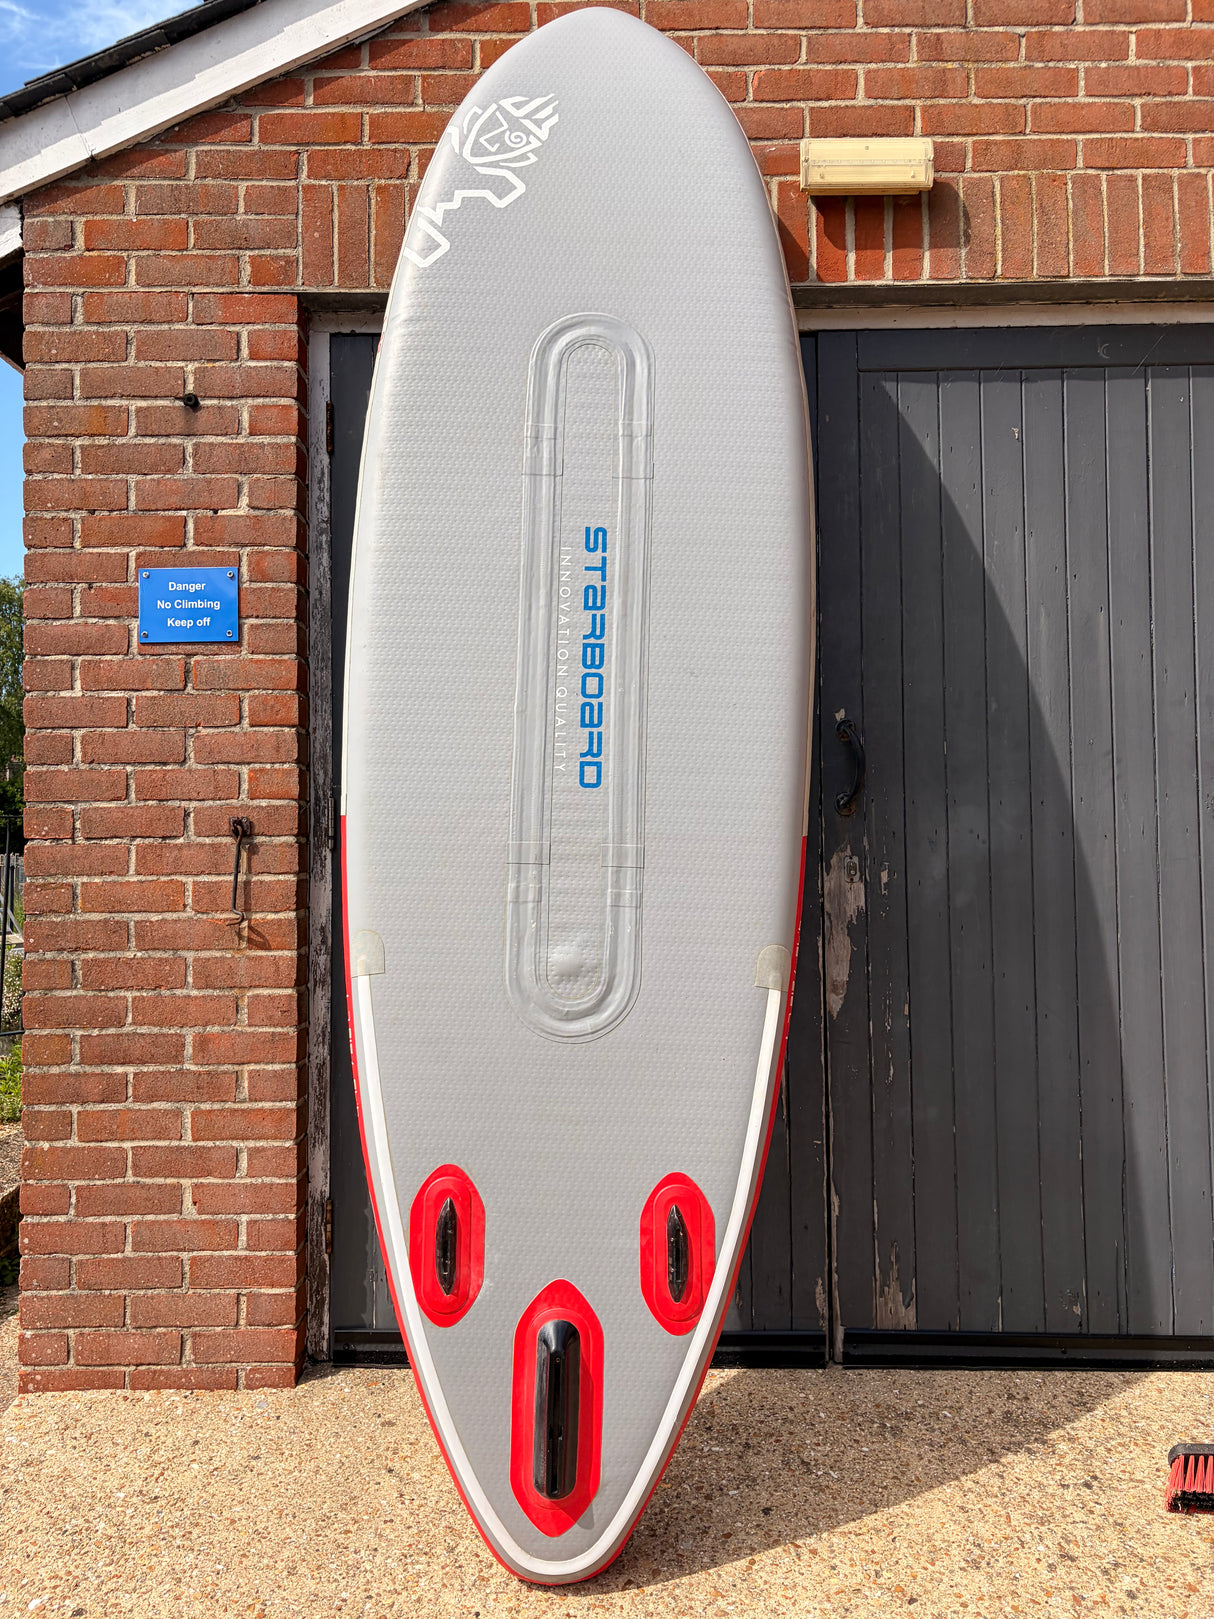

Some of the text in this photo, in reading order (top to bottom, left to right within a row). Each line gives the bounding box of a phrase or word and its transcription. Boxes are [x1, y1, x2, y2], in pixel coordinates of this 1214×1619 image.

[168, 582, 206, 592] Danger
[157, 600, 220, 610] No Climbing
[167, 617, 211, 628] Keep off
[554, 547, 571, 772] INNOVATION QUALITY
